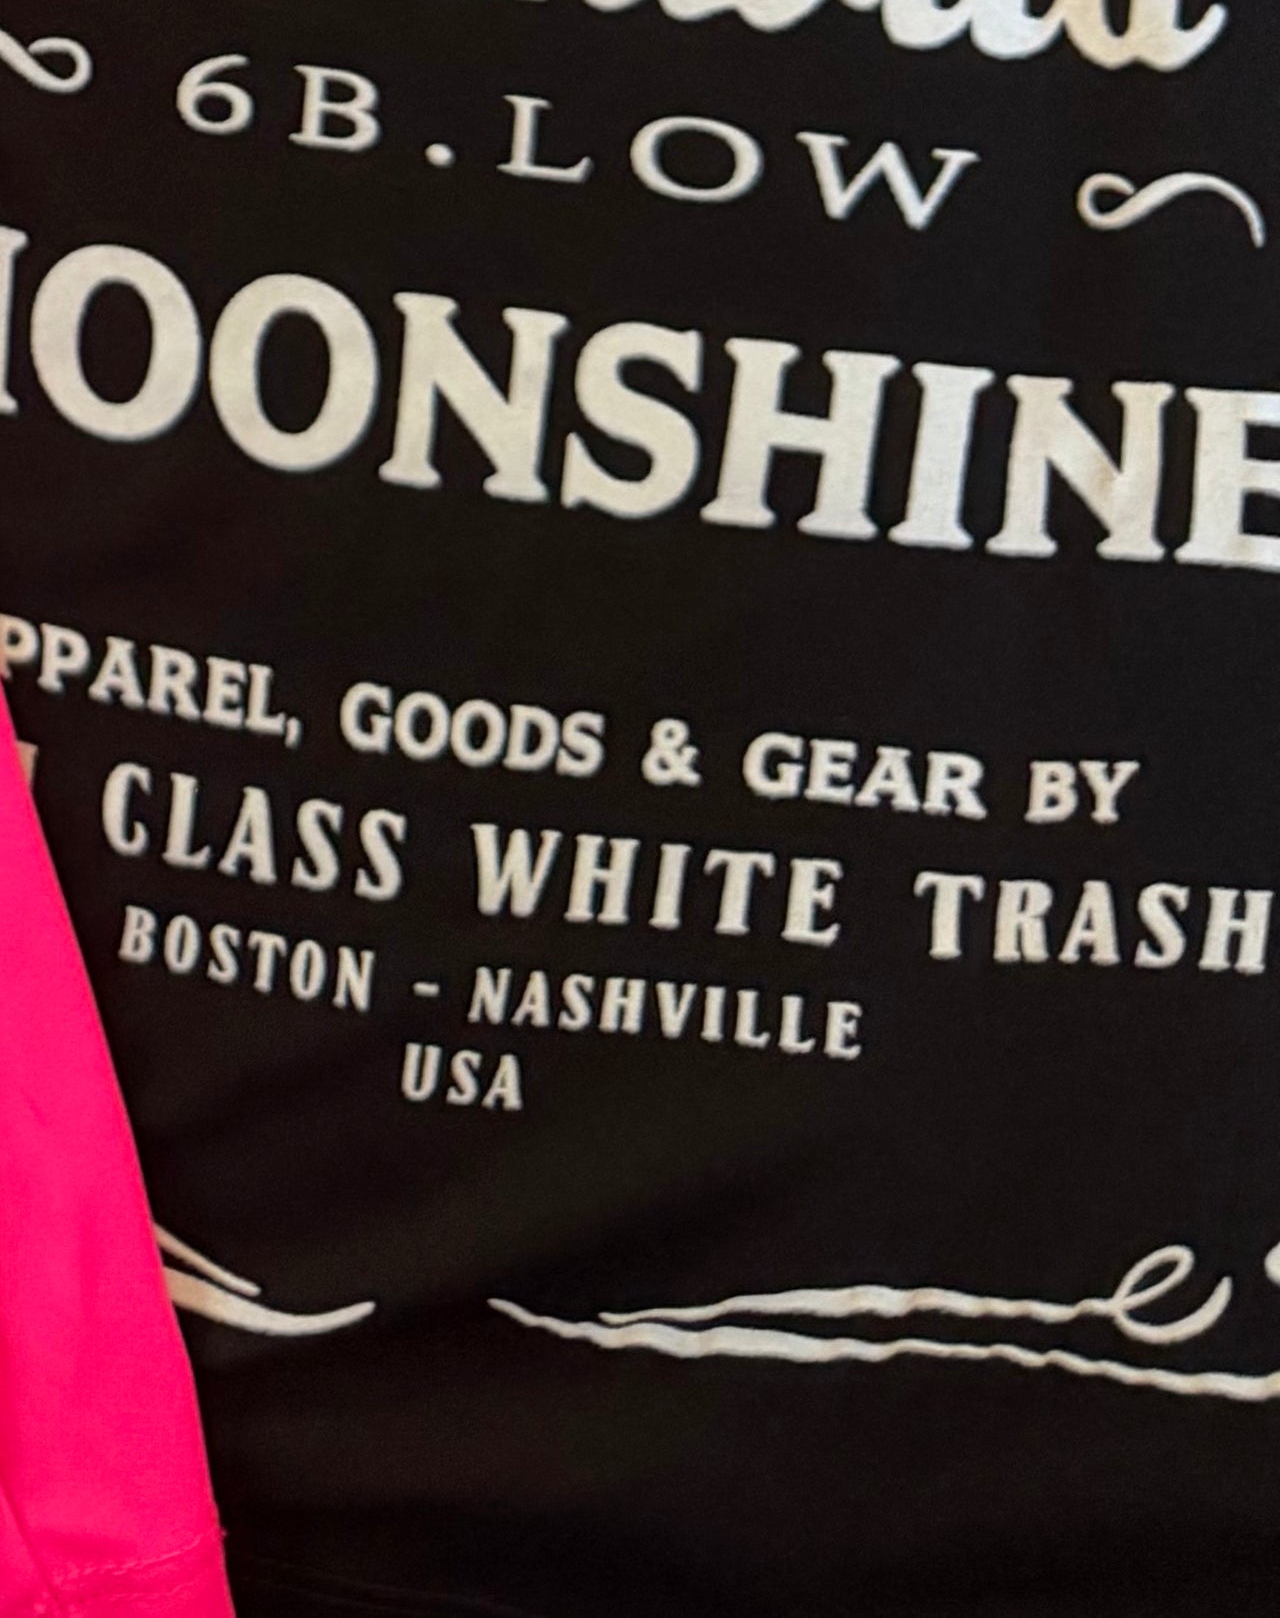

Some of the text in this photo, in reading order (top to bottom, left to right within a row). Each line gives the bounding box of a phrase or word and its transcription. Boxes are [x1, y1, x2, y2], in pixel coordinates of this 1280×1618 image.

[178, 55, 978, 229] 6B.LOW
[341, 683, 603, 776] GOODS
[643, 719, 700, 785] &
[744, 733, 987, 819] GEAR
[1026, 761, 1139, 823] BY
[103, 763, 405, 899] CLASS
[471, 824, 842, 946] WHITE
[914, 872, 1273, 973] TRASH
[119, 904, 375, 1013] BOSTON
[467, 966, 863, 1060] NASHVILLE
[403, 1043, 521, 1109] USA
